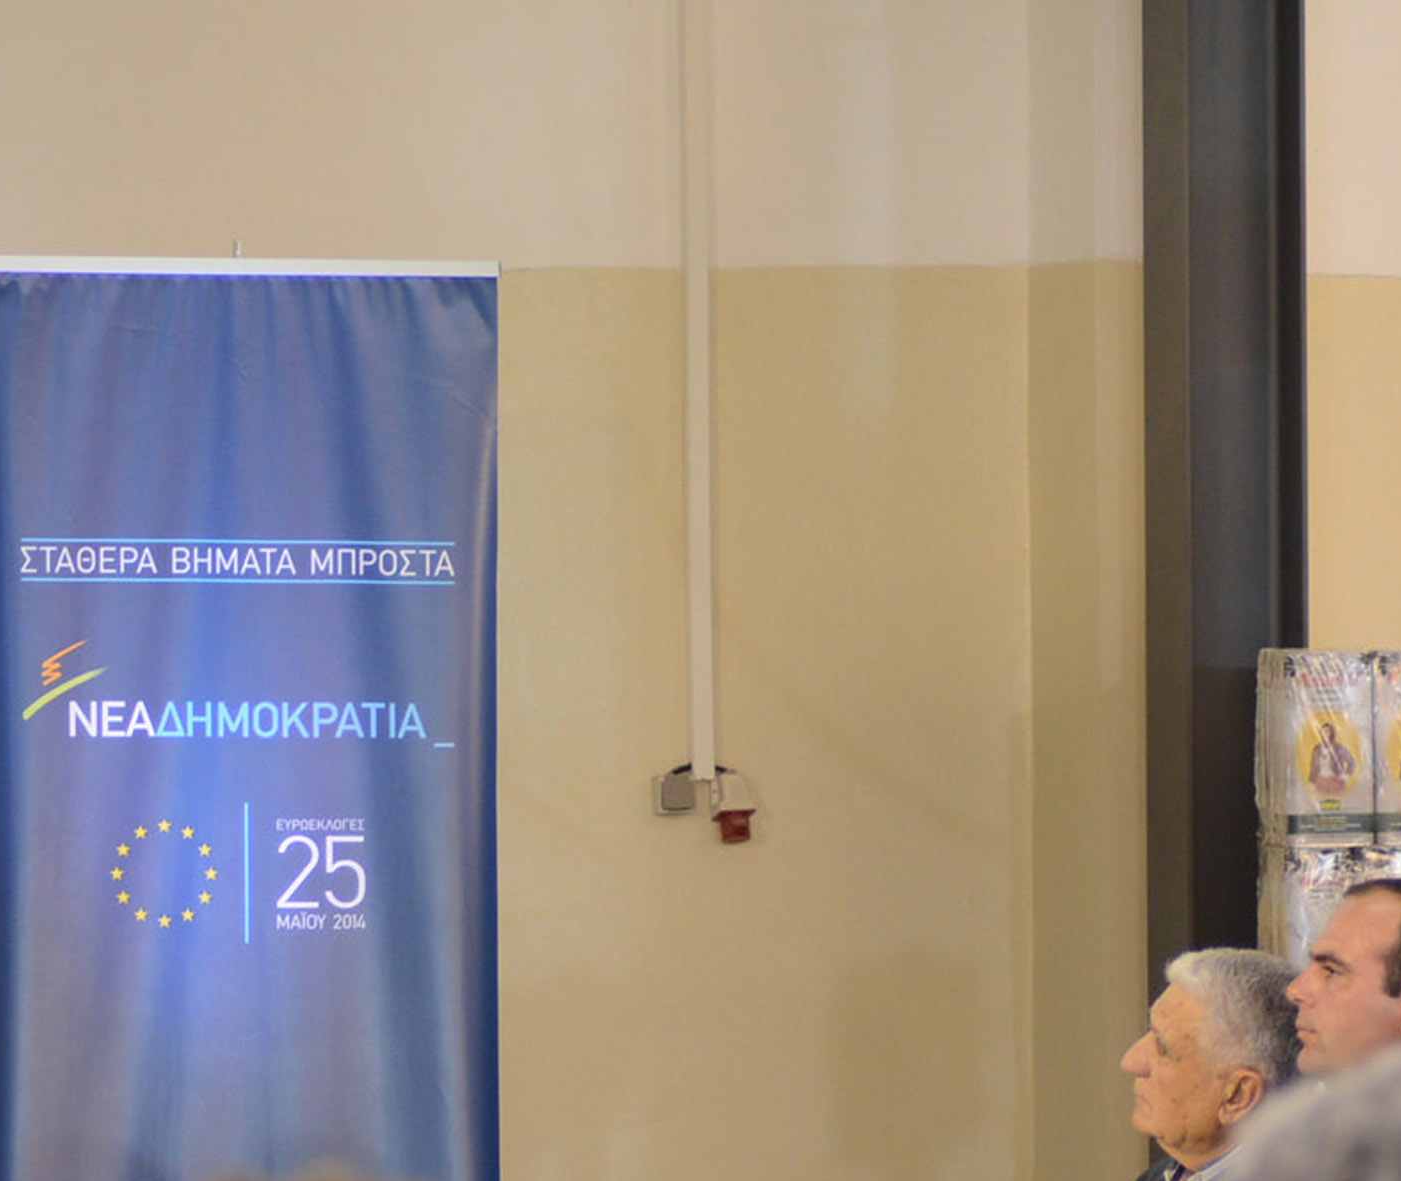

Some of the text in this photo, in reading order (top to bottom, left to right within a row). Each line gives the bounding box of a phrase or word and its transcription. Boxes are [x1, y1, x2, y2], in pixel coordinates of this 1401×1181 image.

[19, 545, 456, 577] ΣΤΑΘΕΡΑ ΒΗΜΑΤΑ ΜΠΡΟΣΤΑ
[275, 818, 365, 831] ΕΥΡΩΕΚΛΟΓΕΣ
[276, 834, 367, 909] 25
[333, 913, 367, 930] 2014
